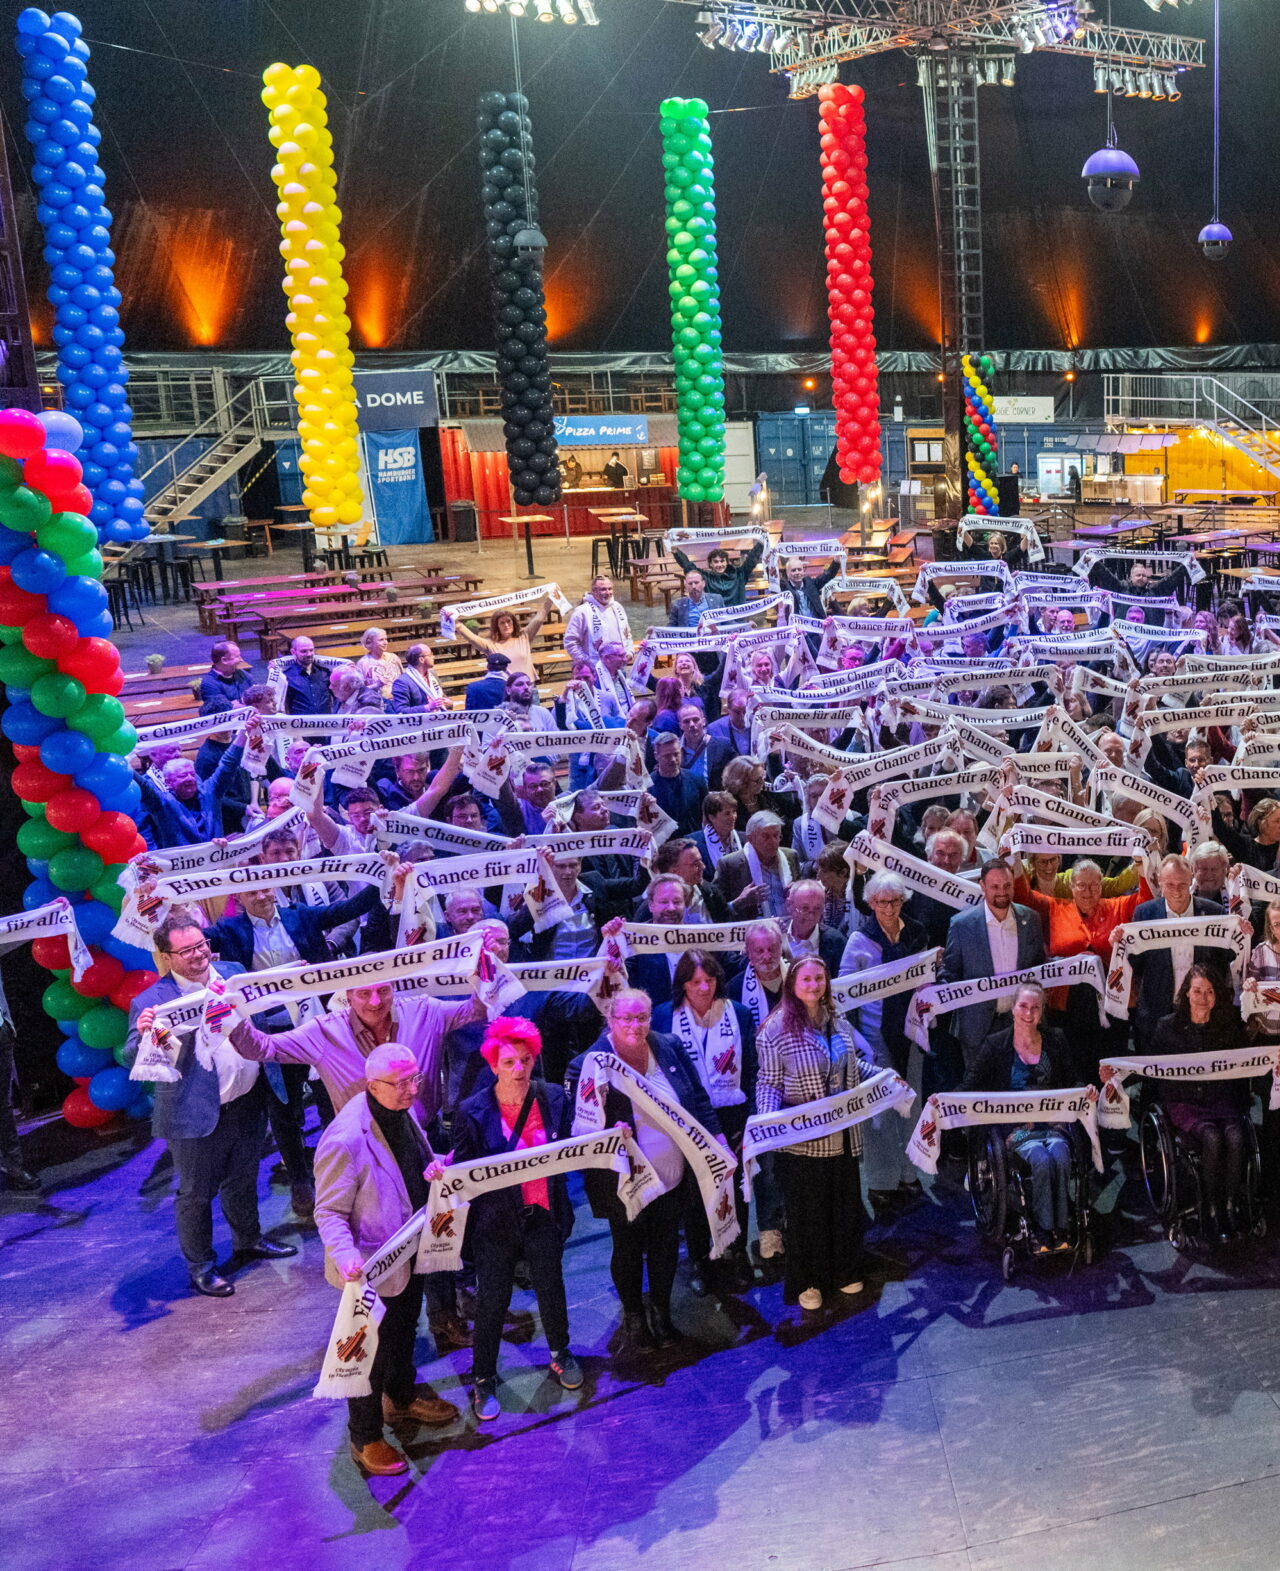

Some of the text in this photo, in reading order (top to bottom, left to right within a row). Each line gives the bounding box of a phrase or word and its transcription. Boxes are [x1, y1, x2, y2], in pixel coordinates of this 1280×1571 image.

[366, 391, 425, 408] DOME
[1012, 407, 1036, 416] CORNER
[564, 425, 633, 437] PIZZA PRIME
[378, 446, 416, 470] HSB
[377, 475, 416, 484] SPORTBUND
[379, 468, 416, 477] HAMBURGER
[695, 527, 750, 538] Eine Chance
[981, 518, 1024, 530] Chance für
[478, 590, 529, 607] Chance für
[702, 597, 779, 622] Eine Chance für
[1038, 631, 1090, 643] Chance für
[835, 678, 879, 694] für alle.
[320, 728, 445, 762] Eine Chance für
[503, 732, 612, 754] Eine Chance für
[844, 742, 948, 785] Eine Chance für
[1196, 770, 1228, 791] Eine
[589, 833, 650, 851] für alle.
[1011, 832, 1131, 848] Eine Chance für
[167, 875, 232, 897] Eine
[236, 865, 314, 885] Chance
[318, 858, 353, 876] für
[849, 838, 966, 900] Eine Chance für
[6, 910, 74, 934] für alle.
[663, 929, 725, 945] Chance
[1137, 923, 1231, 943] Chance für
[239, 939, 475, 1004] Eine Chance für alle.
[935, 961, 1097, 1005] Eine Chance für alle.
[1141, 1052, 1276, 1080] Chance für alle.
[748, 1080, 893, 1144] Eine Chance für alle.
[971, 1097, 1067, 1115] Chance für
[467, 1154, 551, 1183] Chance
[555, 1140, 589, 1161] für
[686, 1120, 728, 1190] für alle.
